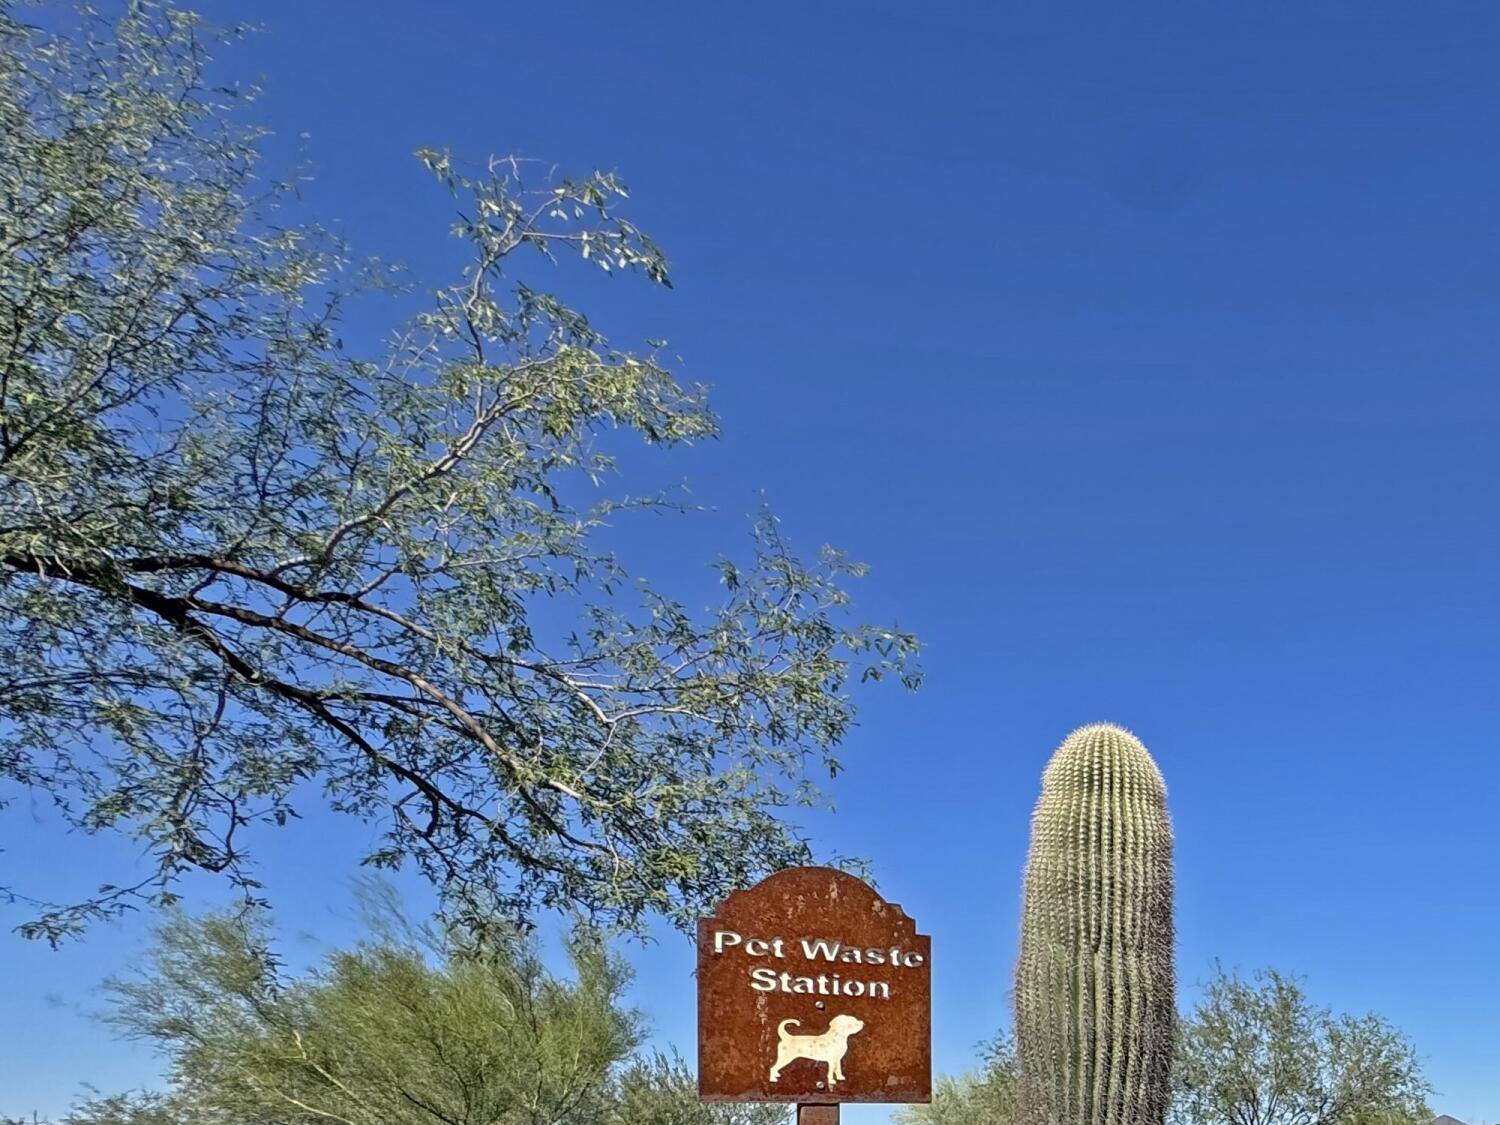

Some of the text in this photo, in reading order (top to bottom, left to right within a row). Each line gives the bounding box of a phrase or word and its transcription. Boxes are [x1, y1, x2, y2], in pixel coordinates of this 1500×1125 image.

[714, 930, 923, 968] Pet Waste
[750, 967, 890, 1000] Station
